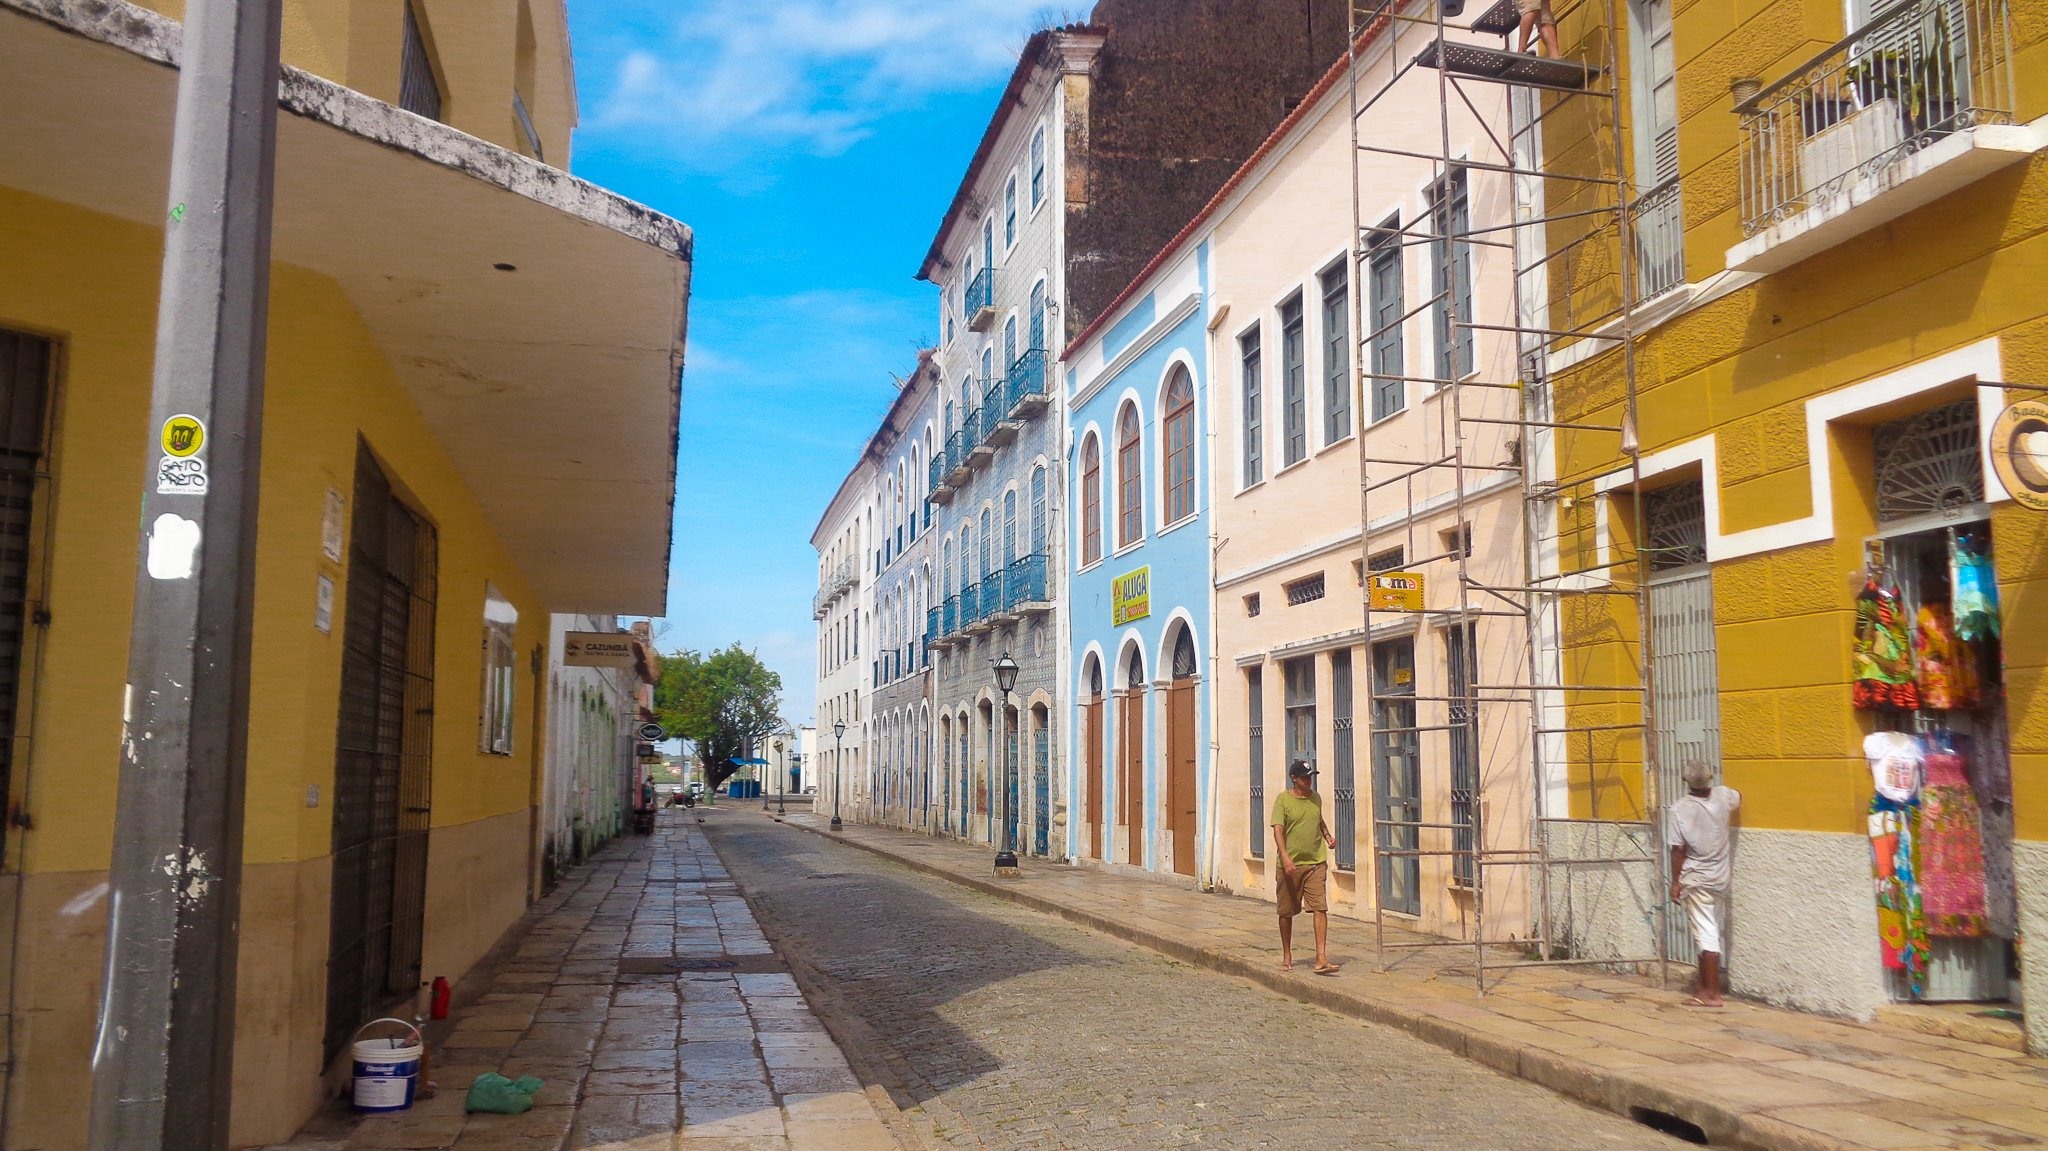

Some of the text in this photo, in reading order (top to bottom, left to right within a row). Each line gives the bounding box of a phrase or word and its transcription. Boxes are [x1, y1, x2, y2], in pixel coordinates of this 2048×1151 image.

[160, 458, 201, 472] GATO
[159, 472, 204, 486] PRETO
[1123, 573, 1146, 602] ALUGA
